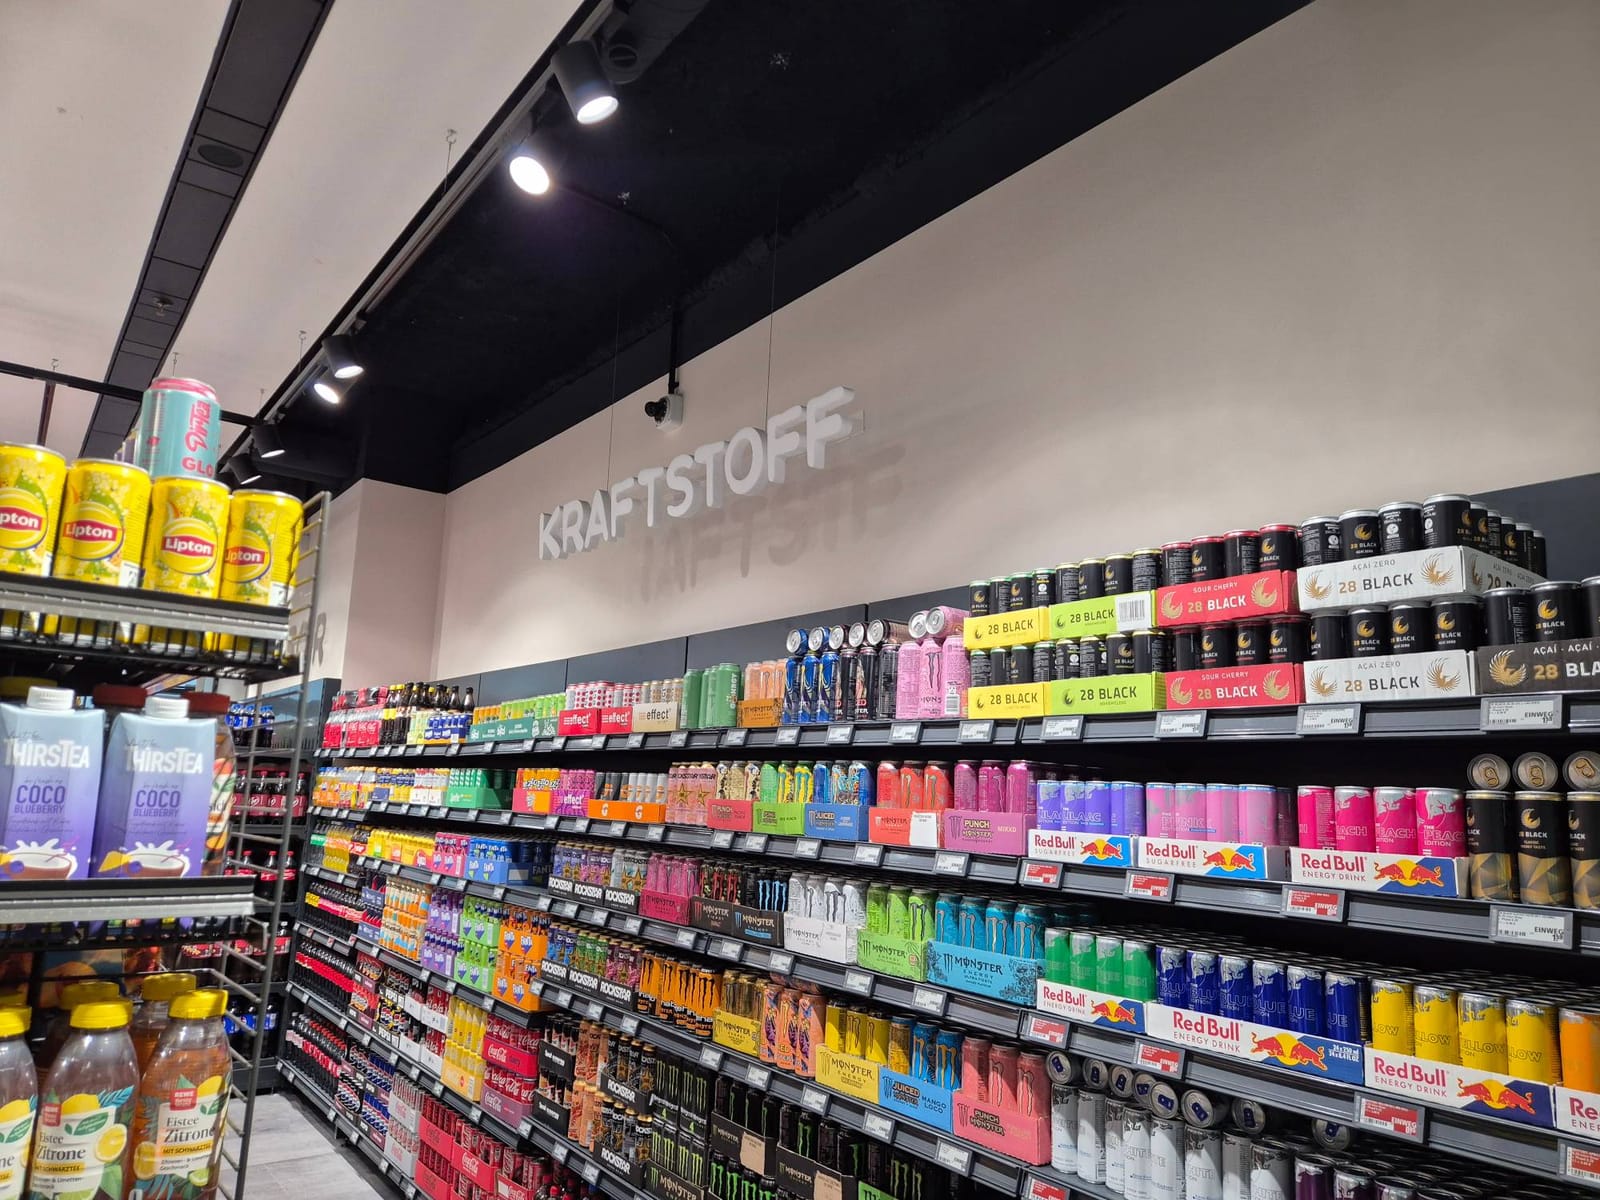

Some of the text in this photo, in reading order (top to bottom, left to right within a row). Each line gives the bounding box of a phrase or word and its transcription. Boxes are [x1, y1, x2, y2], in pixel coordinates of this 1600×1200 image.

[539, 385, 855, 560] KRAFTSTOFF
[65, 524, 113, 539] Lipton
[165, 537, 212, 555] Lipton
[1374, 559, 1396, 569] ZERO
[1193, 581, 1238, 593] SOUR CHERRY
[1339, 573, 1413, 594] 28 BLACK
[1188, 595, 1246, 613] 28 BLACK
[1070, 614, 1081, 623] 28
[1085, 608, 1114, 622] BLACK
[988, 619, 1033, 635] 28 BLACK
[1441, 631, 1461, 639] BLACK
[1533, 641, 1593, 655] AÇAÍ AÇAÍ
[1201, 671, 1249, 680] SOUR CHERRY
[1533, 664, 1559, 680] 28
[1344, 676, 1419, 692] 28 BLACK
[990, 692, 1038, 705] 28 BLACK
[1080, 686, 1137, 701] 28 BLACK
[1197, 685, 1258, 700] 28 BLACK
[646, 709, 669, 720] effect
[1524, 711, 1554, 719] EINWEG
[16, 785, 66, 804] COCO
[135, 790, 181, 808] COCO
[14, 804, 65, 814] BLUEBERRY
[964, 820, 990, 828] PUNCH
[1034, 834, 1075, 850] Red Bull
[1035, 849, 1075, 857] SUGARFREE
[1146, 842, 1196, 860] Red Bull
[1146, 858, 1196, 868] SUGARFREE
[1301, 853, 1365, 872] Red Bull
[549, 876, 573, 892] ROCKSTAR
[1302, 871, 1366, 882] ENERGY DRINK
[574, 883, 602, 899] ROCKSTAR
[605, 889, 635, 905] ROCKSTAR
[702, 905, 729, 917] MONSTER
[742, 915, 775, 927] MONSTER
[792, 929, 819, 940] MONSTER
[1534, 926, 1565, 935] EINWEG
[872, 943, 905, 959] MONSTER
[541, 960, 567, 978] ROCKSTAR
[954, 956, 1003, 975] MONSTER
[569, 970, 598, 989] ROCKSTAR
[600, 981, 631, 1001] ROCKSTAR
[1043, 986, 1085, 1008] Red Bull
[1043, 1002, 1066, 1011] ENERGY
[723, 1021, 751, 1036] MONSTER
[1173, 1011, 1240, 1041] Red Bull
[1174, 1031, 1240, 1053] ENERGY DRINK
[831, 1057, 873, 1079] MONSTER
[1374, 1057, 1446, 1087] Red Bull
[607, 1079, 636, 1103] ROCKSTAR
[893, 1081, 920, 1098] JUICED
[1375, 1076, 1447, 1098] ENERGY DRINK
[921, 1095, 947, 1109] MANGO
[924, 1103, 944, 1114] LOCO
[167, 1117, 199, 1127] Eistee
[974, 1108, 999, 1124] PUNCH
[970, 1116, 1005, 1136] MONSTER
[164, 1127, 215, 1143] Zitrone
[36, 1144, 86, 1160] Zitrone
[601, 1148, 631, 1175] ROCKSTAR
[660, 1174, 698, 1200] MONSTER
